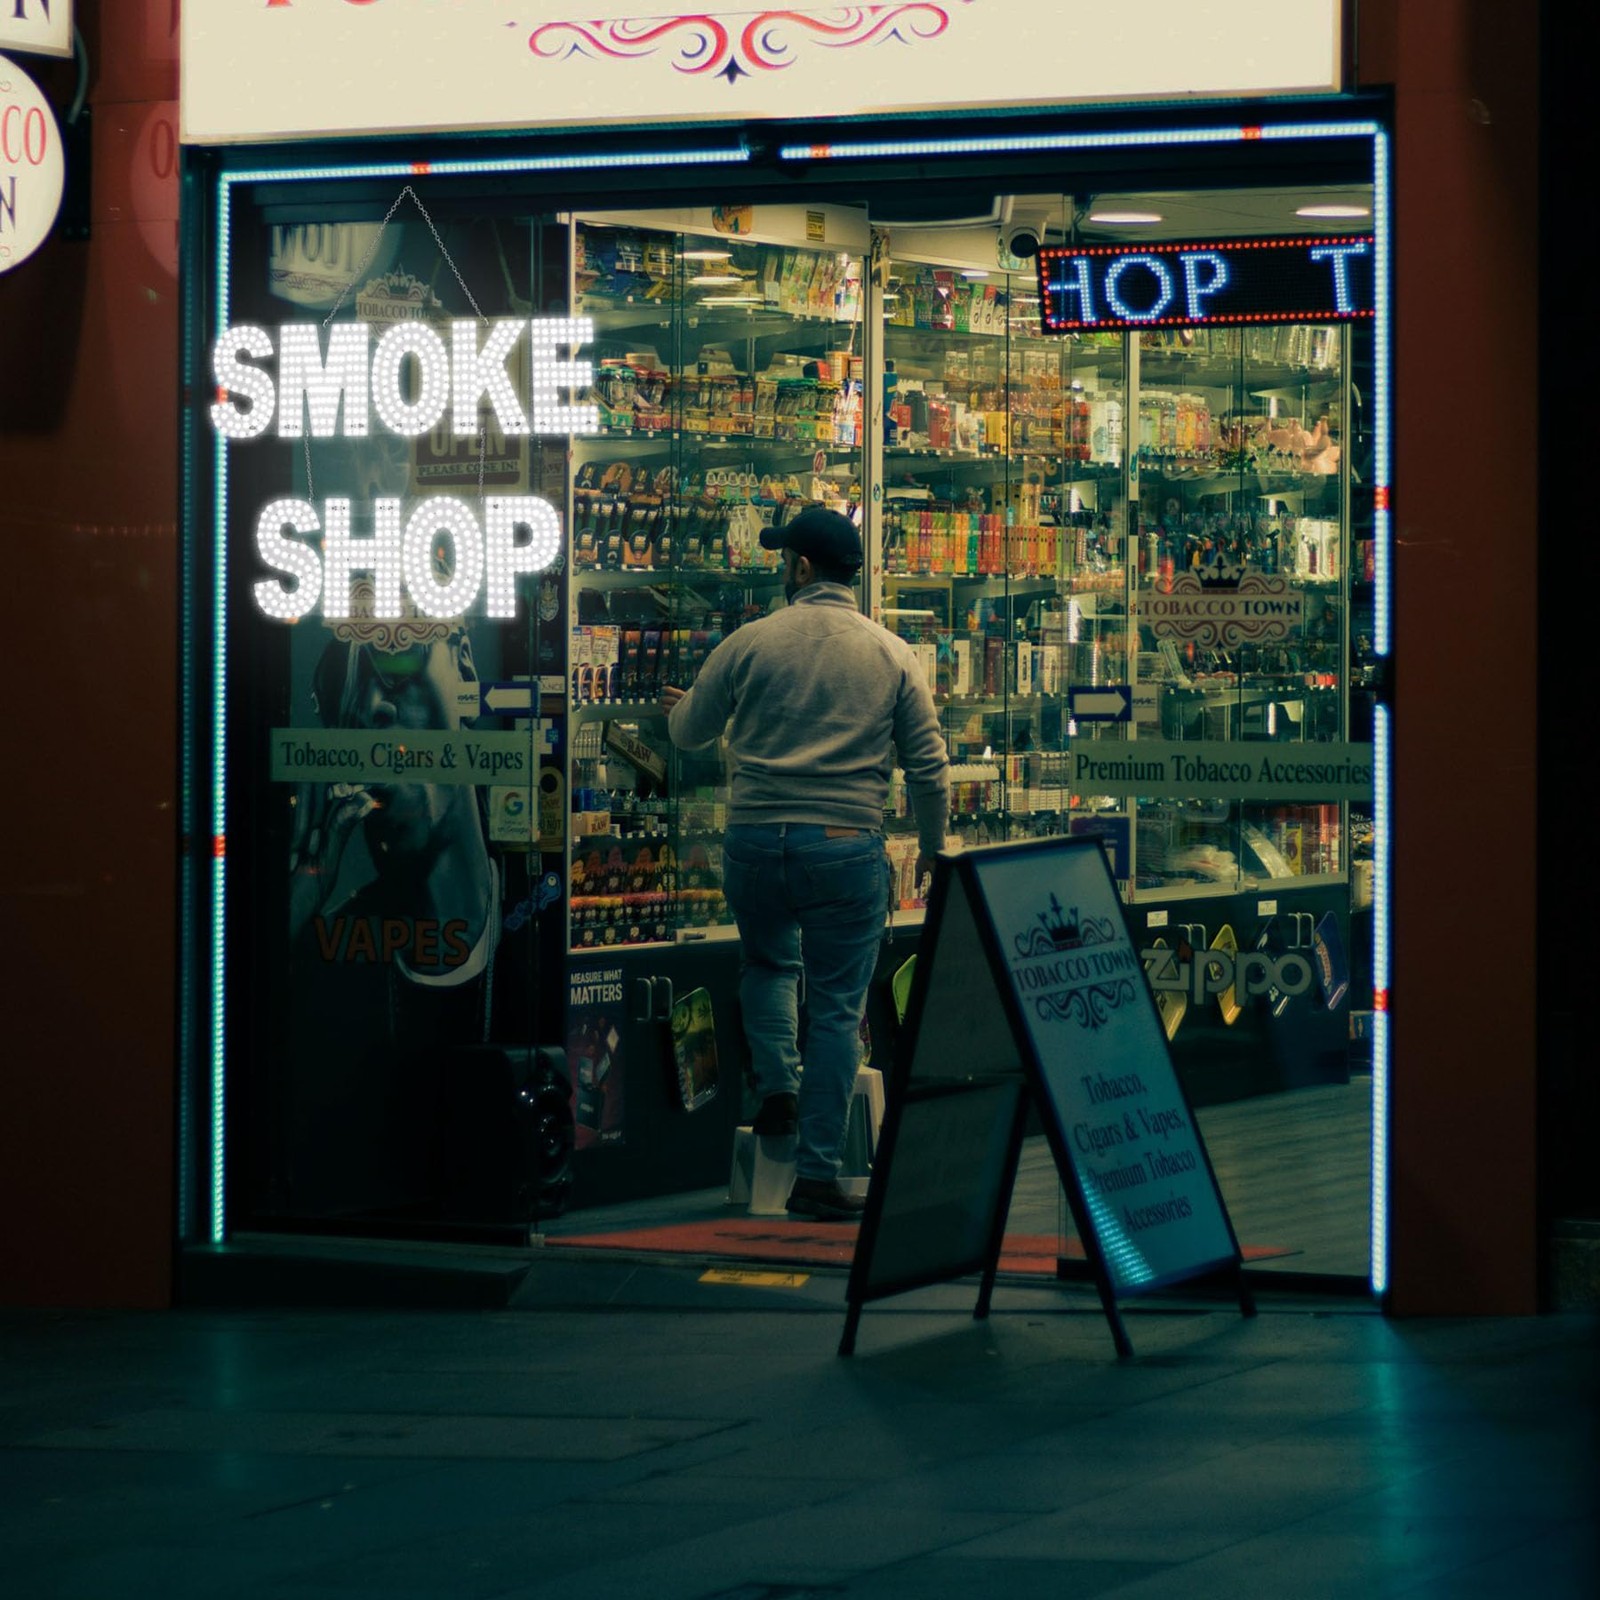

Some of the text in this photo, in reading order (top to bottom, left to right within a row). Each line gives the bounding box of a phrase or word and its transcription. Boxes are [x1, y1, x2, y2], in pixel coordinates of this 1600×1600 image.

[1310, 241, 1367, 315] T
[209, 316, 599, 440] SMOKE
[418, 463, 464, 476] PLEASE
[254, 496, 562, 619] SHOP
[1140, 600, 1301, 616] TOBACCO TOWN
[281, 741, 524, 774] Tobacco, Cigars & Vapes
[626, 738, 652, 763] RAW
[1076, 753, 1371, 785] Premium Tobacco Accessories
[312, 915, 471, 966] VAPES
[570, 968, 623, 985] MEASURE WHAT
[1011, 948, 1136, 991] TOBACCO TOWN
[570, 983, 623, 1006] MATTERS
[1081, 1072, 1148, 1105] Tobacco,
[1073, 1122, 1123, 1158] Cigars
[1123, 1110, 1140, 1141] &
[1087, 1149, 1197, 1194] Premium Tobacco
[1122, 1189, 1193, 1233] Accessories
